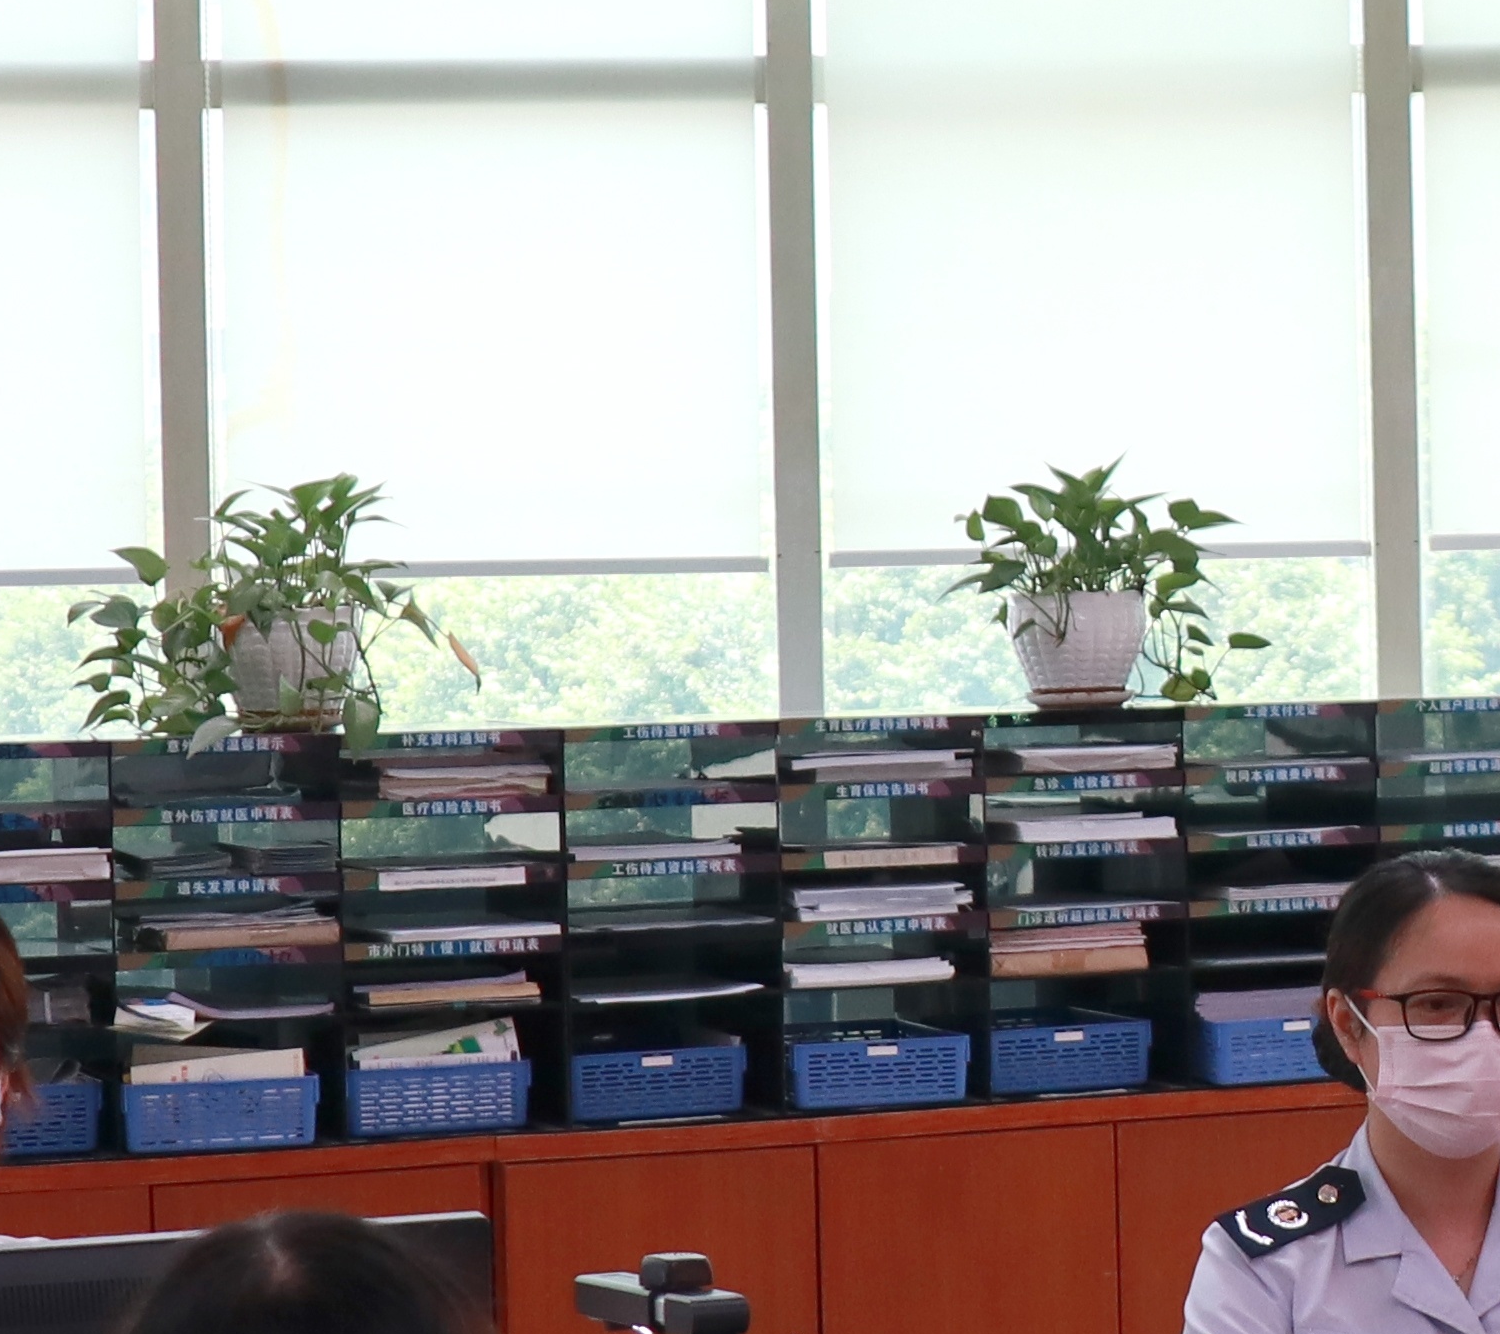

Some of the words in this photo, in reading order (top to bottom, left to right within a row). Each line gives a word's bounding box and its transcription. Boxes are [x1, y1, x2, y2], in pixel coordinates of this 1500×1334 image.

[623, 723, 720, 739] 工伤待遇申报表
[814, 716, 950, 732] 生育医疗费待遇申请表
[401, 731, 501, 748] 补充资料通知书
[836, 782, 930, 798] 生育保险告知书
[161, 806, 294, 824] 意外伤害就医申请表
[402, 799, 502, 816] 医疗保险告知书
[612, 858, 739, 876] 工伤待遇资料签收表
[177, 877, 282, 896] 遗失发票申请表
[827, 916, 949, 936] 就医确认变更申请表
